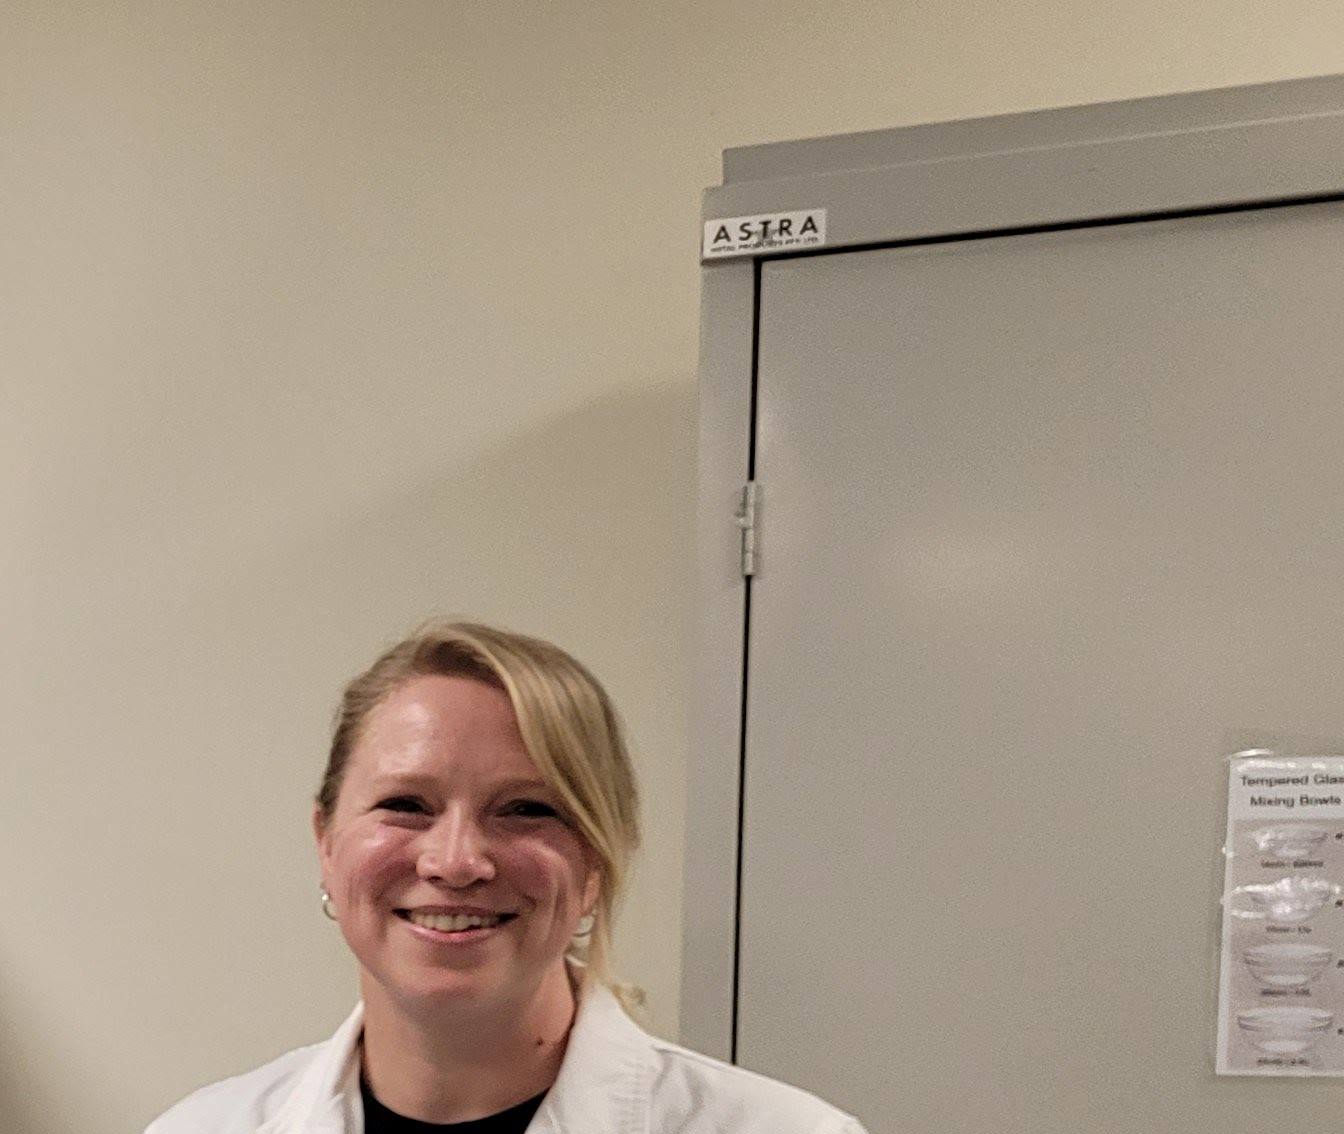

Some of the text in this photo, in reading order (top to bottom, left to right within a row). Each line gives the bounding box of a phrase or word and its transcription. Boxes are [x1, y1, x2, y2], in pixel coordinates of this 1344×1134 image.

[713, 215, 818, 244] ASTRA
[1240, 774, 1309, 787] Tempered
[1250, 794, 1342, 808] Mixing Bowls
